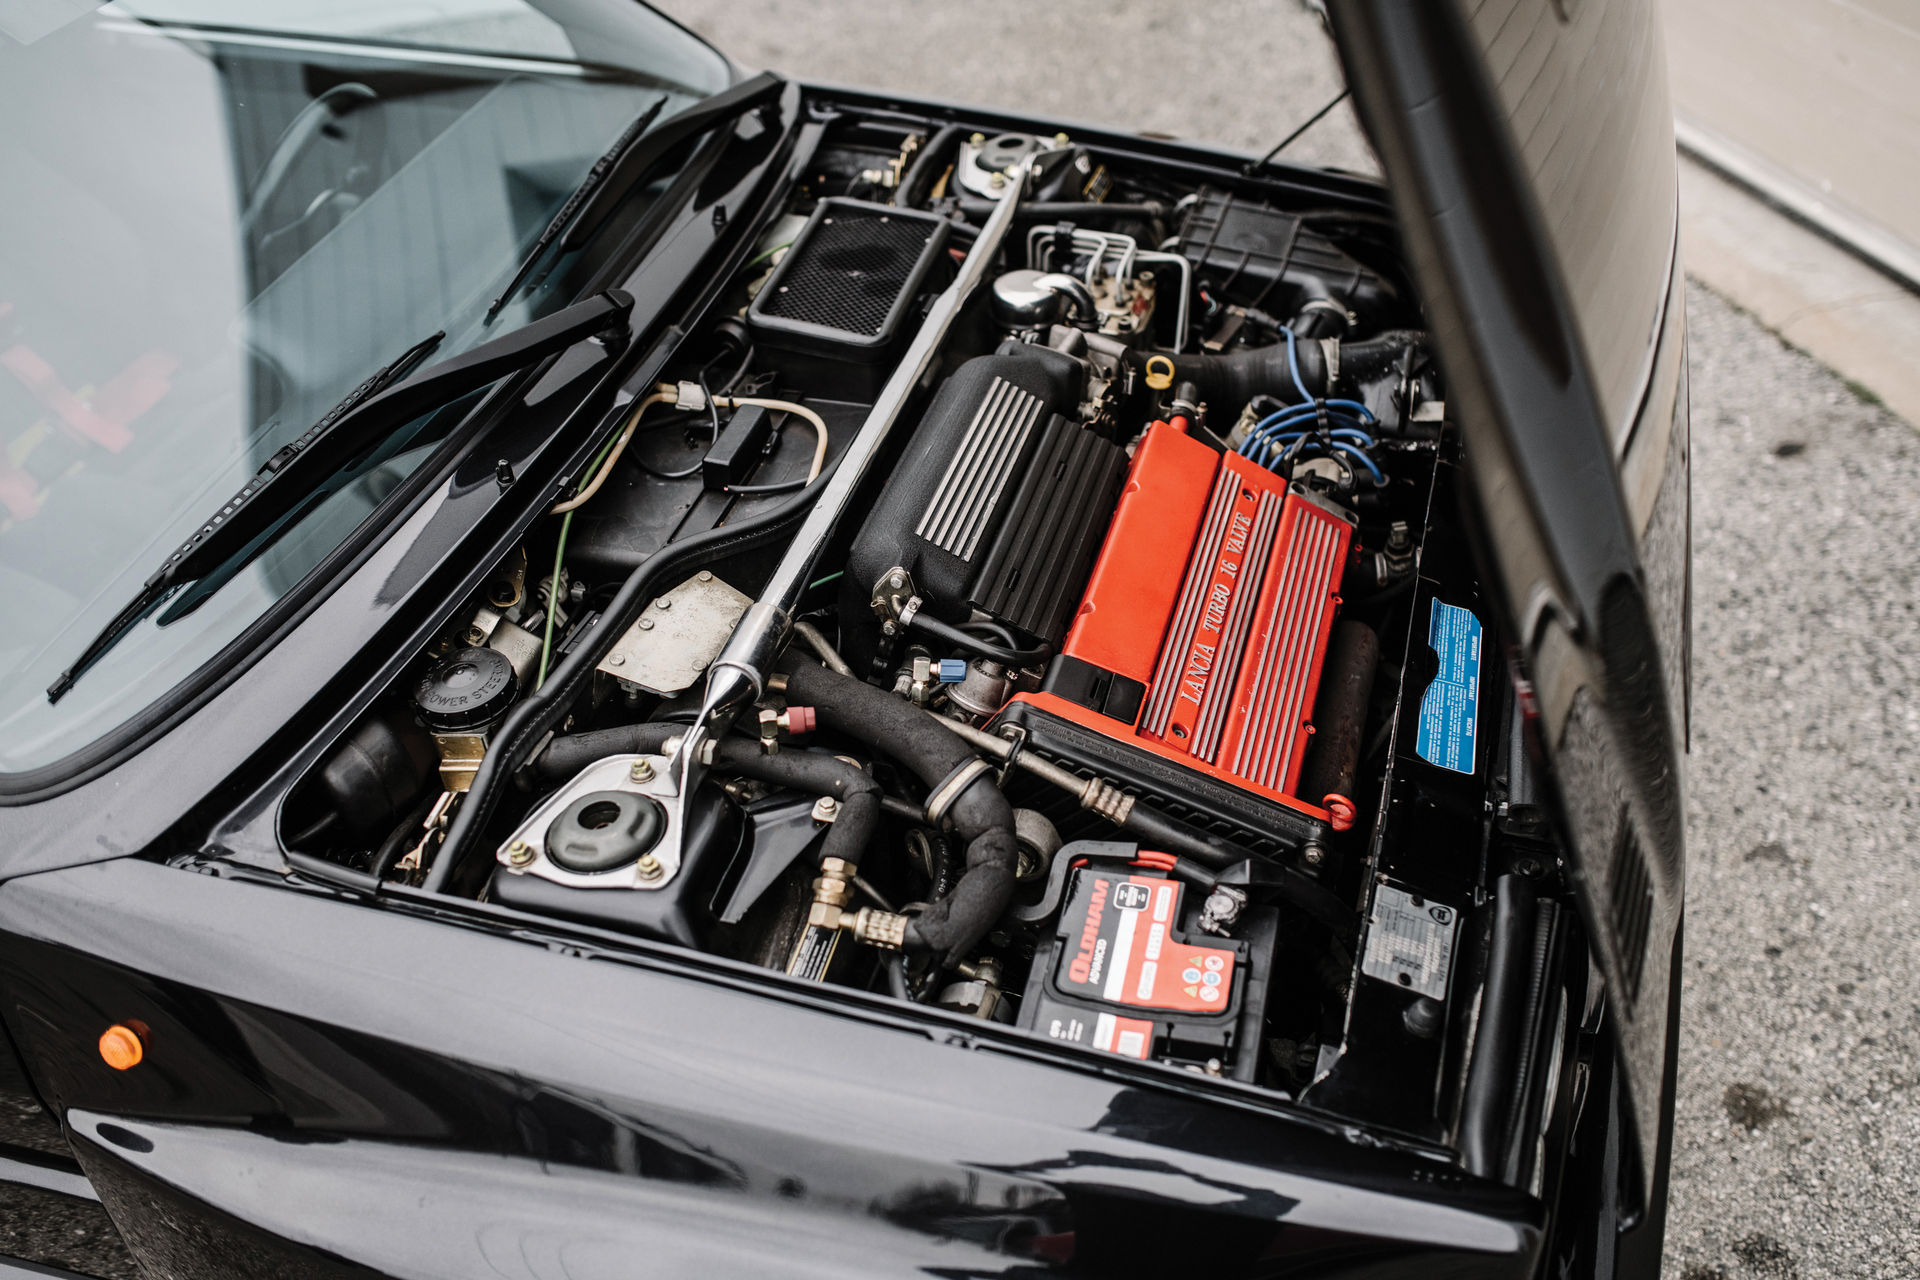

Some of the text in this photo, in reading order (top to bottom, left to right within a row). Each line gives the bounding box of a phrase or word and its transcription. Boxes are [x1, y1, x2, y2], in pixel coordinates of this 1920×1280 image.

[1181, 511, 1251, 706] LANCIA TURBO 16 VALVE
[425, 691, 469, 707] POWER
[1069, 879, 1109, 984] OLDHAM
[1088, 938, 1107, 984] ADVANCED
